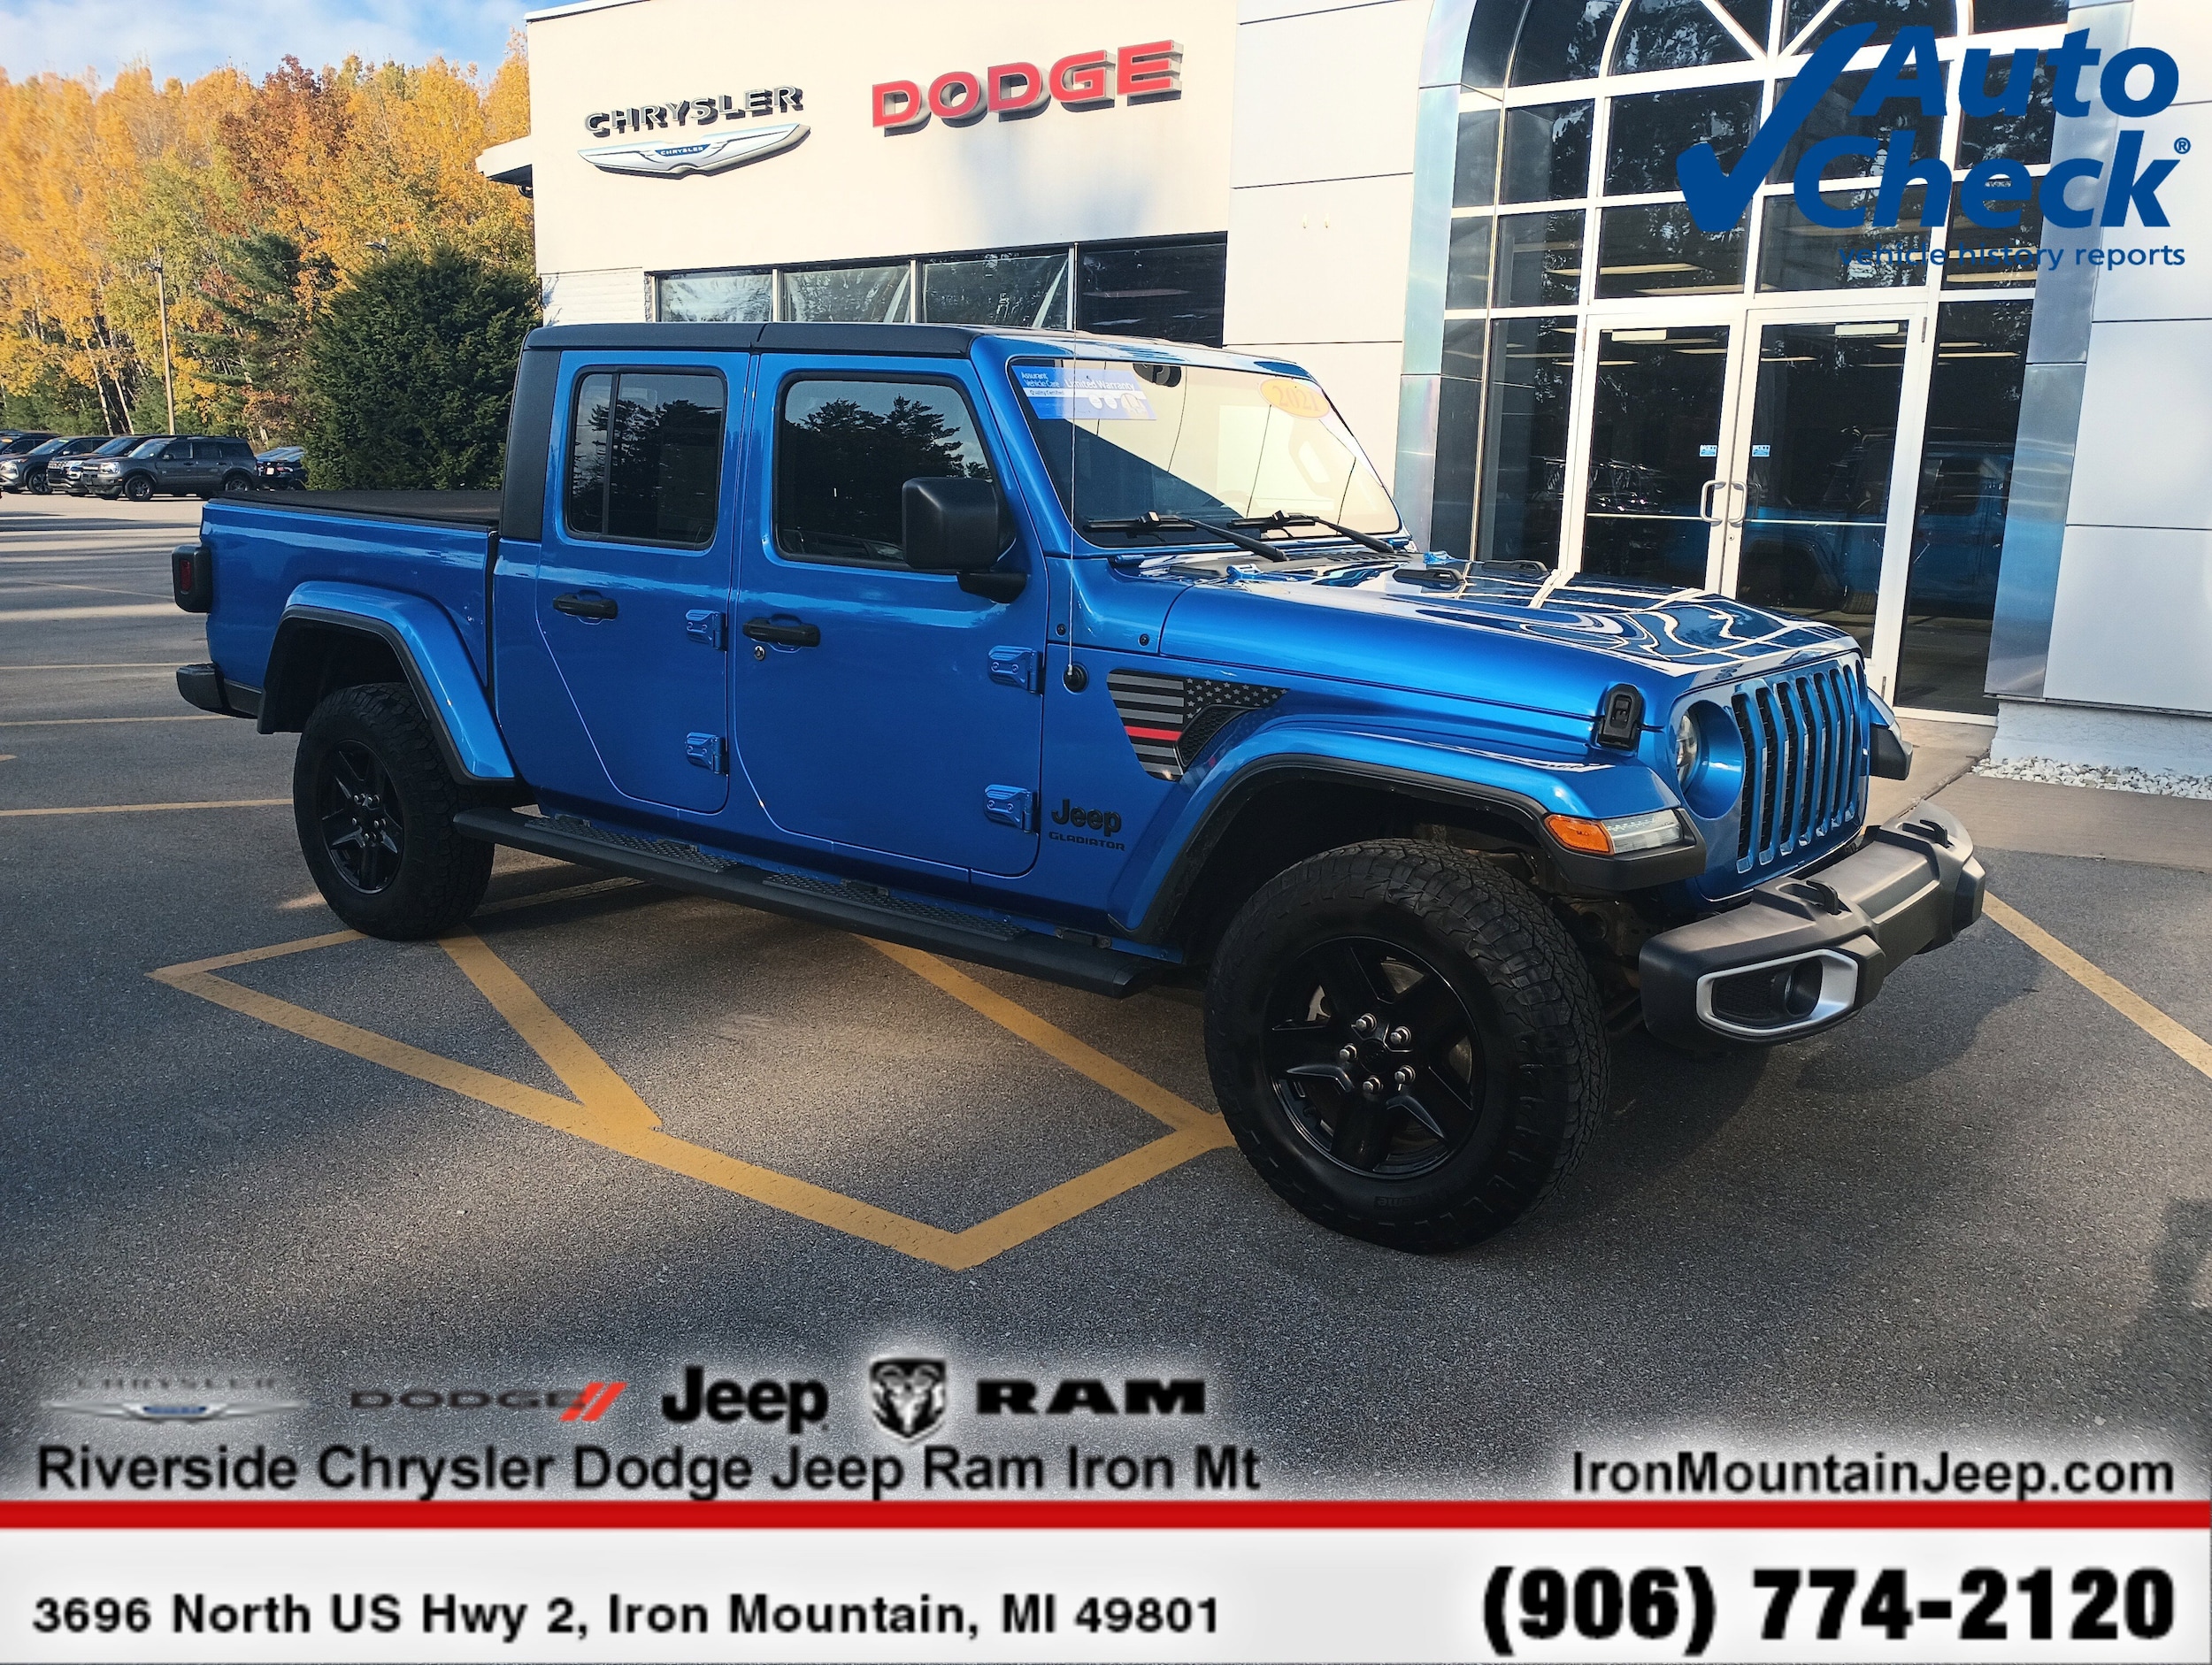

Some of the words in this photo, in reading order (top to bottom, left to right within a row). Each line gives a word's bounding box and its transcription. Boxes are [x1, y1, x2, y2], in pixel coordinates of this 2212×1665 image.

[872, 40, 1179, 130] DODGE
[584, 84, 801, 134] CHRYSLER
[1021, 372, 1048, 380] Assurant
[1064, 379, 1097, 389] Limited
[1097, 380, 1135, 392] Warranty
[1051, 799, 1122, 837] Jeep
[1048, 832, 1125, 851] GLADIATOR
